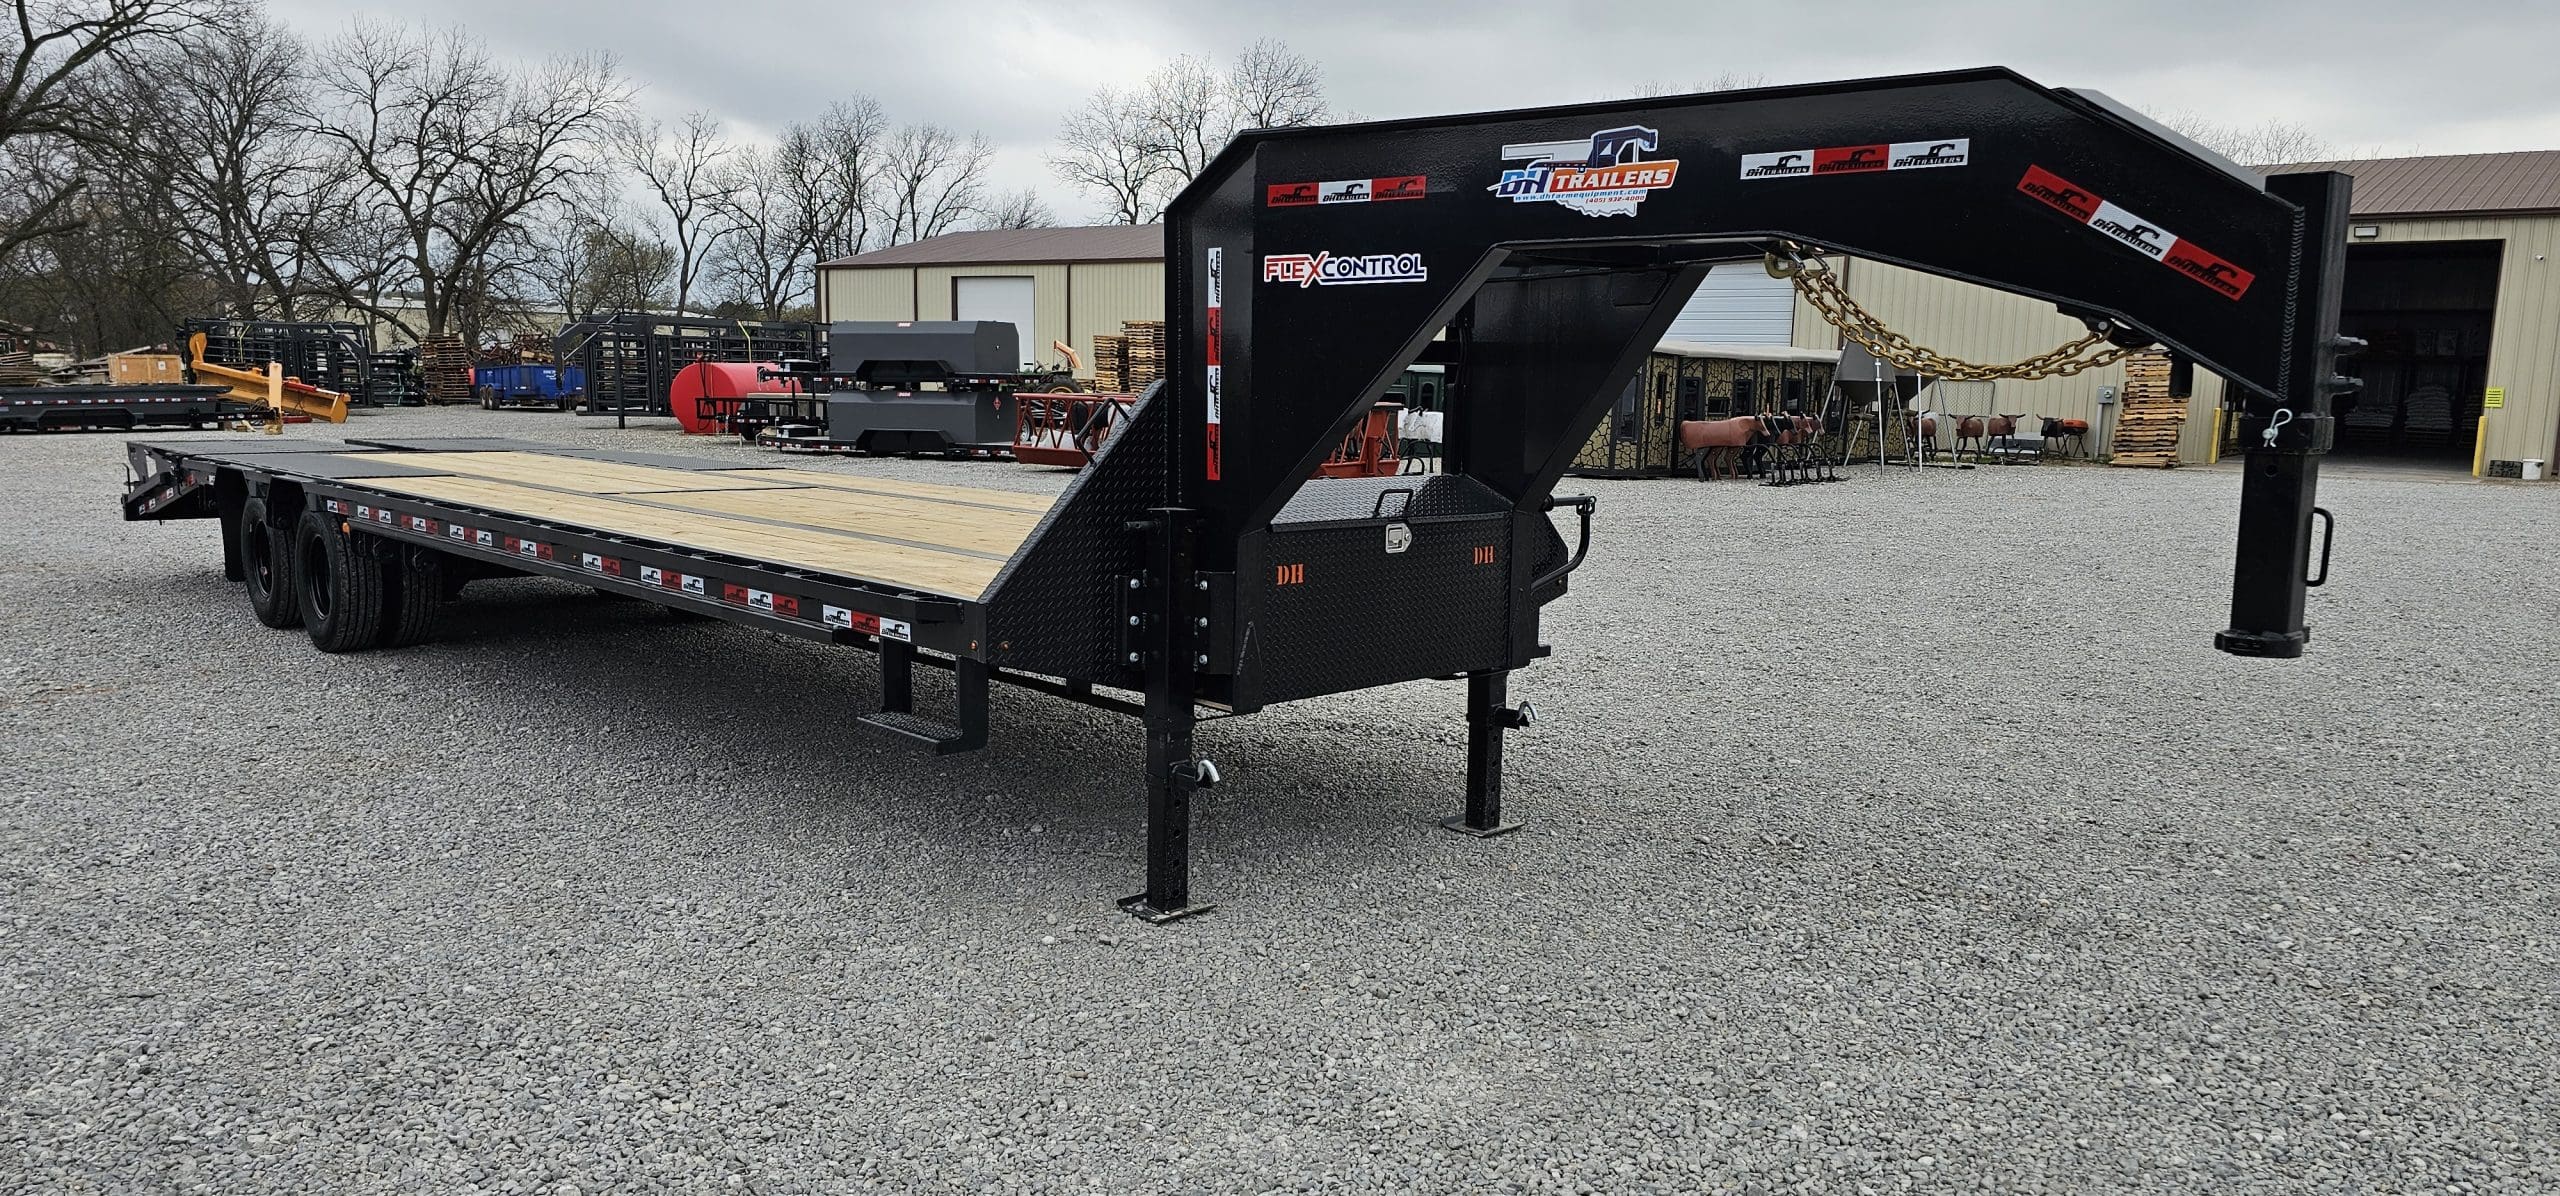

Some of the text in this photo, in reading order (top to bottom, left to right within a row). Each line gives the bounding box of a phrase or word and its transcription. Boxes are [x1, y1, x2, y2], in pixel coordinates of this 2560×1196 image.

[1499, 168, 1671, 196] DH TRAILERS
[1515, 189, 1646, 201] www.dhfarmequipment.com
[1474, 546, 1495, 564] DH
[1276, 564, 1304, 585] DH
